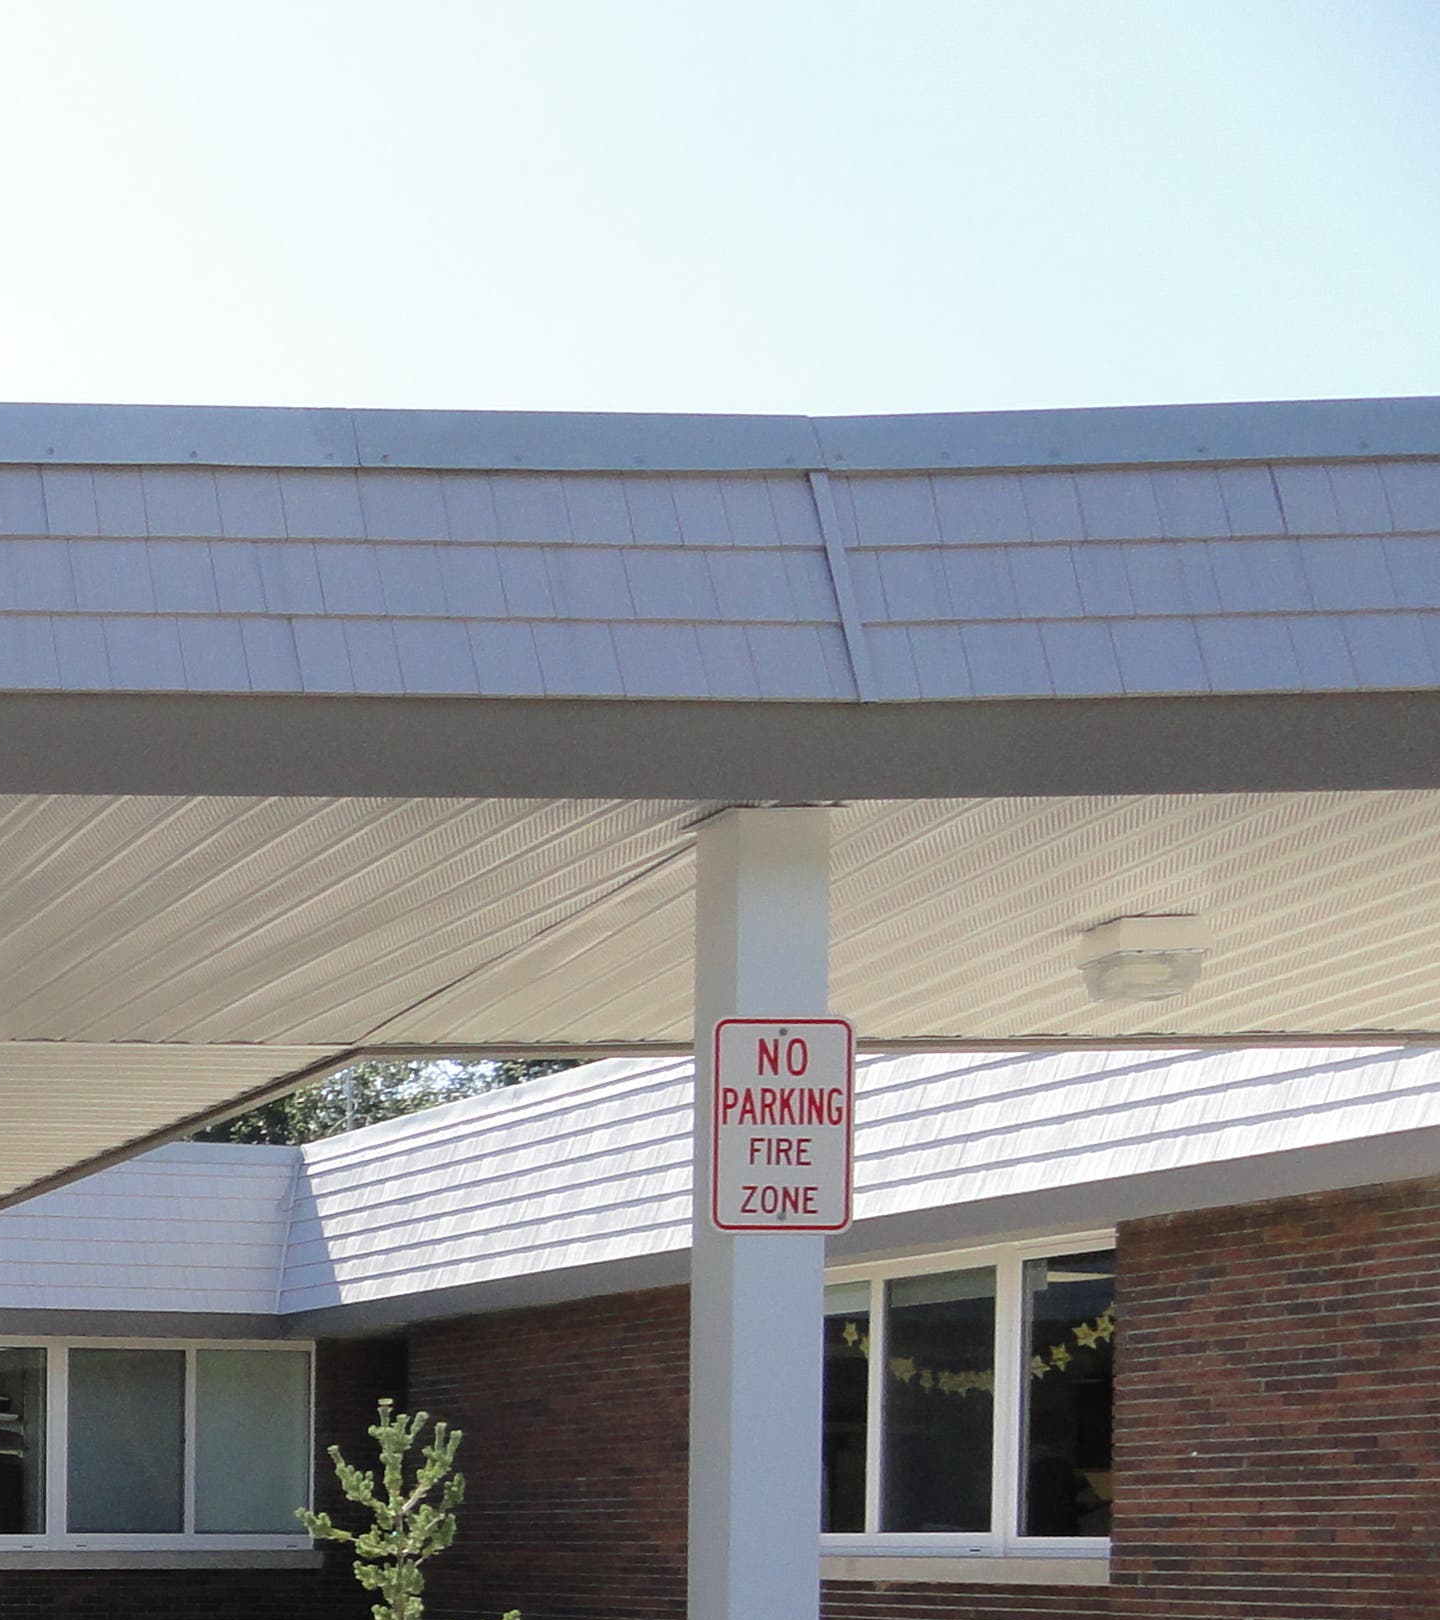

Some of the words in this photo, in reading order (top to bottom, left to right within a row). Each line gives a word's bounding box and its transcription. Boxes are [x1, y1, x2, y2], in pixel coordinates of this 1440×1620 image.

[758, 1038, 808, 1076] NO
[722, 1087, 844, 1125] PARKING
[749, 1138, 812, 1166] FIRE
[740, 1186, 819, 1214] ZONE
